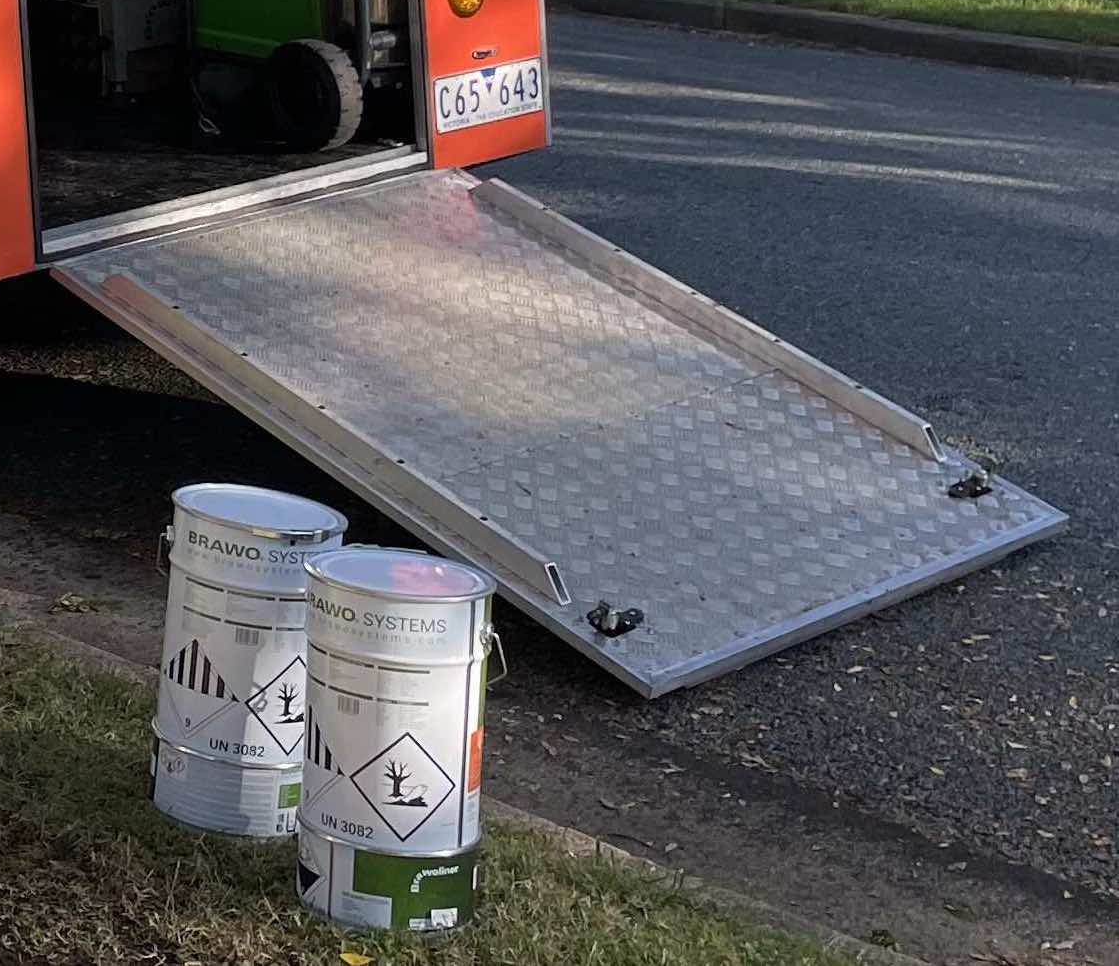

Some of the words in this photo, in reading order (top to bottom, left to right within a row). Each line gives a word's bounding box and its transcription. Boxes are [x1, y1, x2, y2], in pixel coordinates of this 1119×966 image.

[439, 79, 480, 119] C65
[499, 67, 539, 105] 643
[188, 530, 260, 560] BRAWO
[268, 549, 305, 564] SYST
[363, 611, 447, 634] SYSTEMS
[209, 738, 229, 752] UN
[232, 742, 265, 757] 3082
[321, 812, 337, 829] UN
[341, 820, 374, 839] 3082
